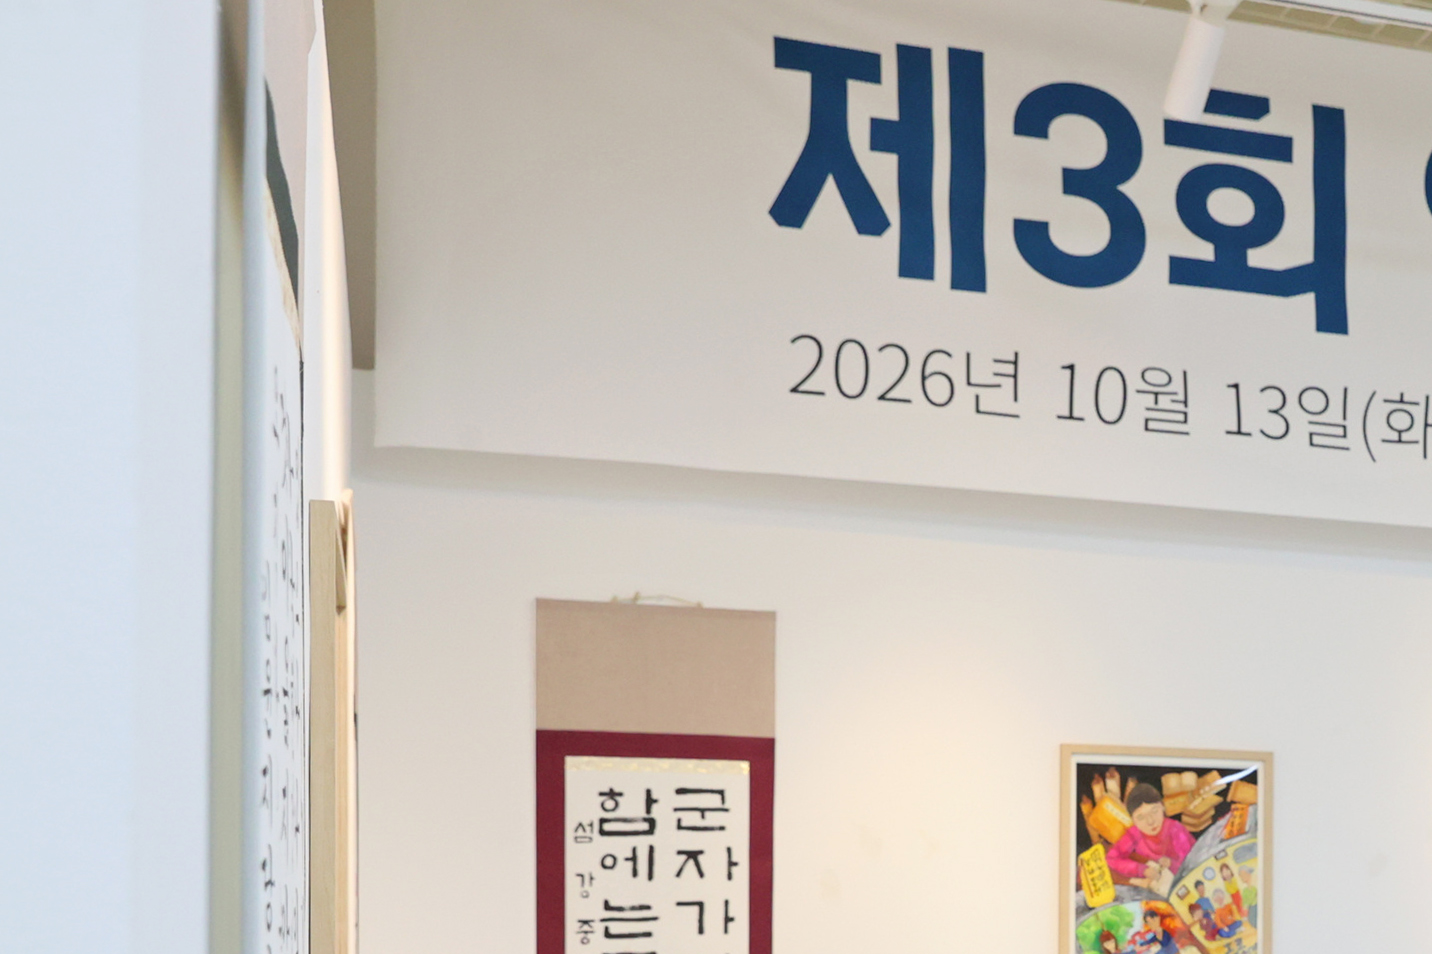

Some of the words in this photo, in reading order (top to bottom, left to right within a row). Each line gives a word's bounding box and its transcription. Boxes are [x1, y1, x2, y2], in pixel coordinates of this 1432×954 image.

[768, 36, 1349, 336] 제3회
[788, 333, 1021, 419] 2026년
[1055, 362, 1191, 437] 10월
